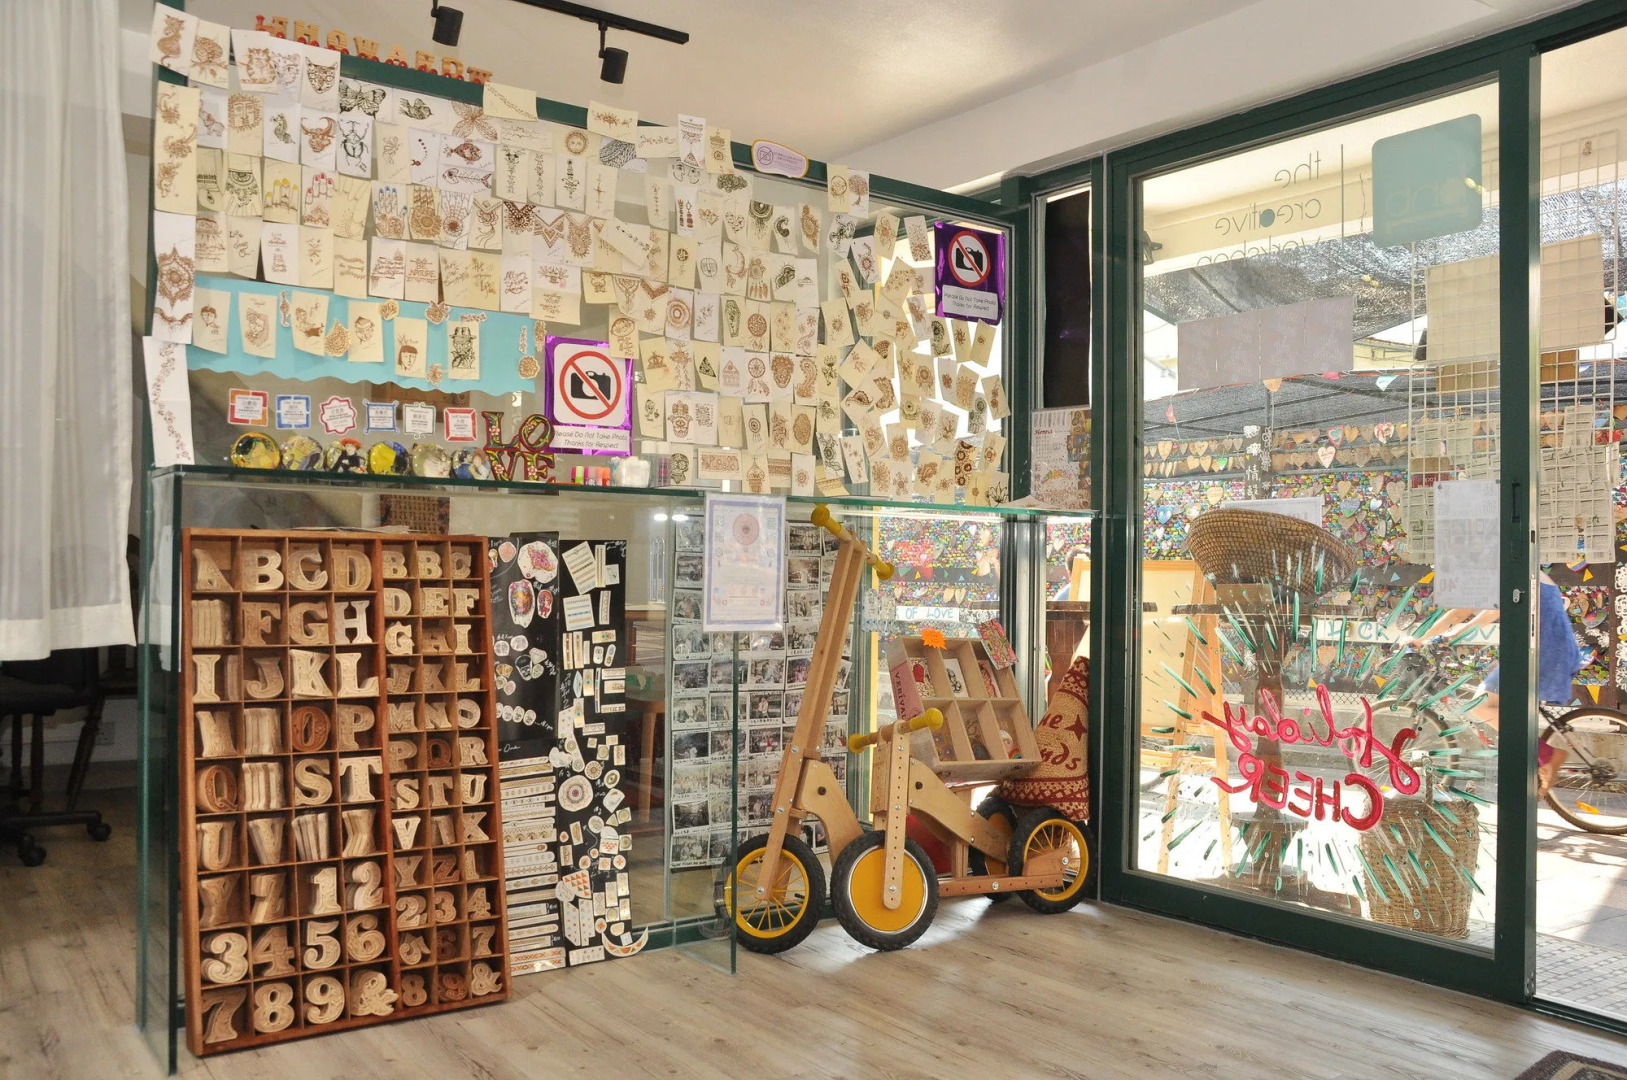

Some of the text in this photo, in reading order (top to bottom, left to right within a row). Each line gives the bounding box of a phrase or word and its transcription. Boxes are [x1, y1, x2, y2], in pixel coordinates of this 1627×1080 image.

[555, 429, 573, 439] lease
[574, 431, 583, 439] Do
[597, 432, 611, 441] Take
[612, 433, 628, 442] Photo
[564, 439, 619, 450] Thanks for Respect
[195, 548, 372, 591] A B C D
[383, 550, 472, 578] B B C
[384, 588, 412, 616] D
[422, 587, 450, 616] E
[453, 588, 479, 616] F
[905, 607, 954, 619] OF LOVE
[243, 600, 372, 645] F G H
[384, 621, 414, 655] G
[454, 624, 472, 654] I
[1327, 620, 1390, 641] LCK
[193, 649, 379, 702] I J K L
[387, 663, 414, 693] J
[456, 662, 480, 690] L
[292, 705, 330, 752] O
[338, 705, 374, 750] P
[388, 698, 481, 732] M N O
[389, 740, 417, 771] P
[459, 736, 488, 765] R
[295, 758, 333, 805] S
[339, 756, 383, 802] T
[393, 774, 487, 809] S T U
[197, 820, 237, 871] U
[392, 816, 421, 850] V
[310, 866, 342, 915] 1
[345, 861, 383, 910] 2
[395, 855, 424, 888] Y
[433, 854, 460, 884] Z
[397, 888, 490, 927] 2 3 4
[202, 914, 386, 984] 3 4 5 6
[437, 929, 457, 959] 6
[471, 925, 496, 956] 7
[401, 974, 428, 1006] 8
[470, 962, 502, 996] &
[202, 969, 399, 1044] 7 8 9 &
